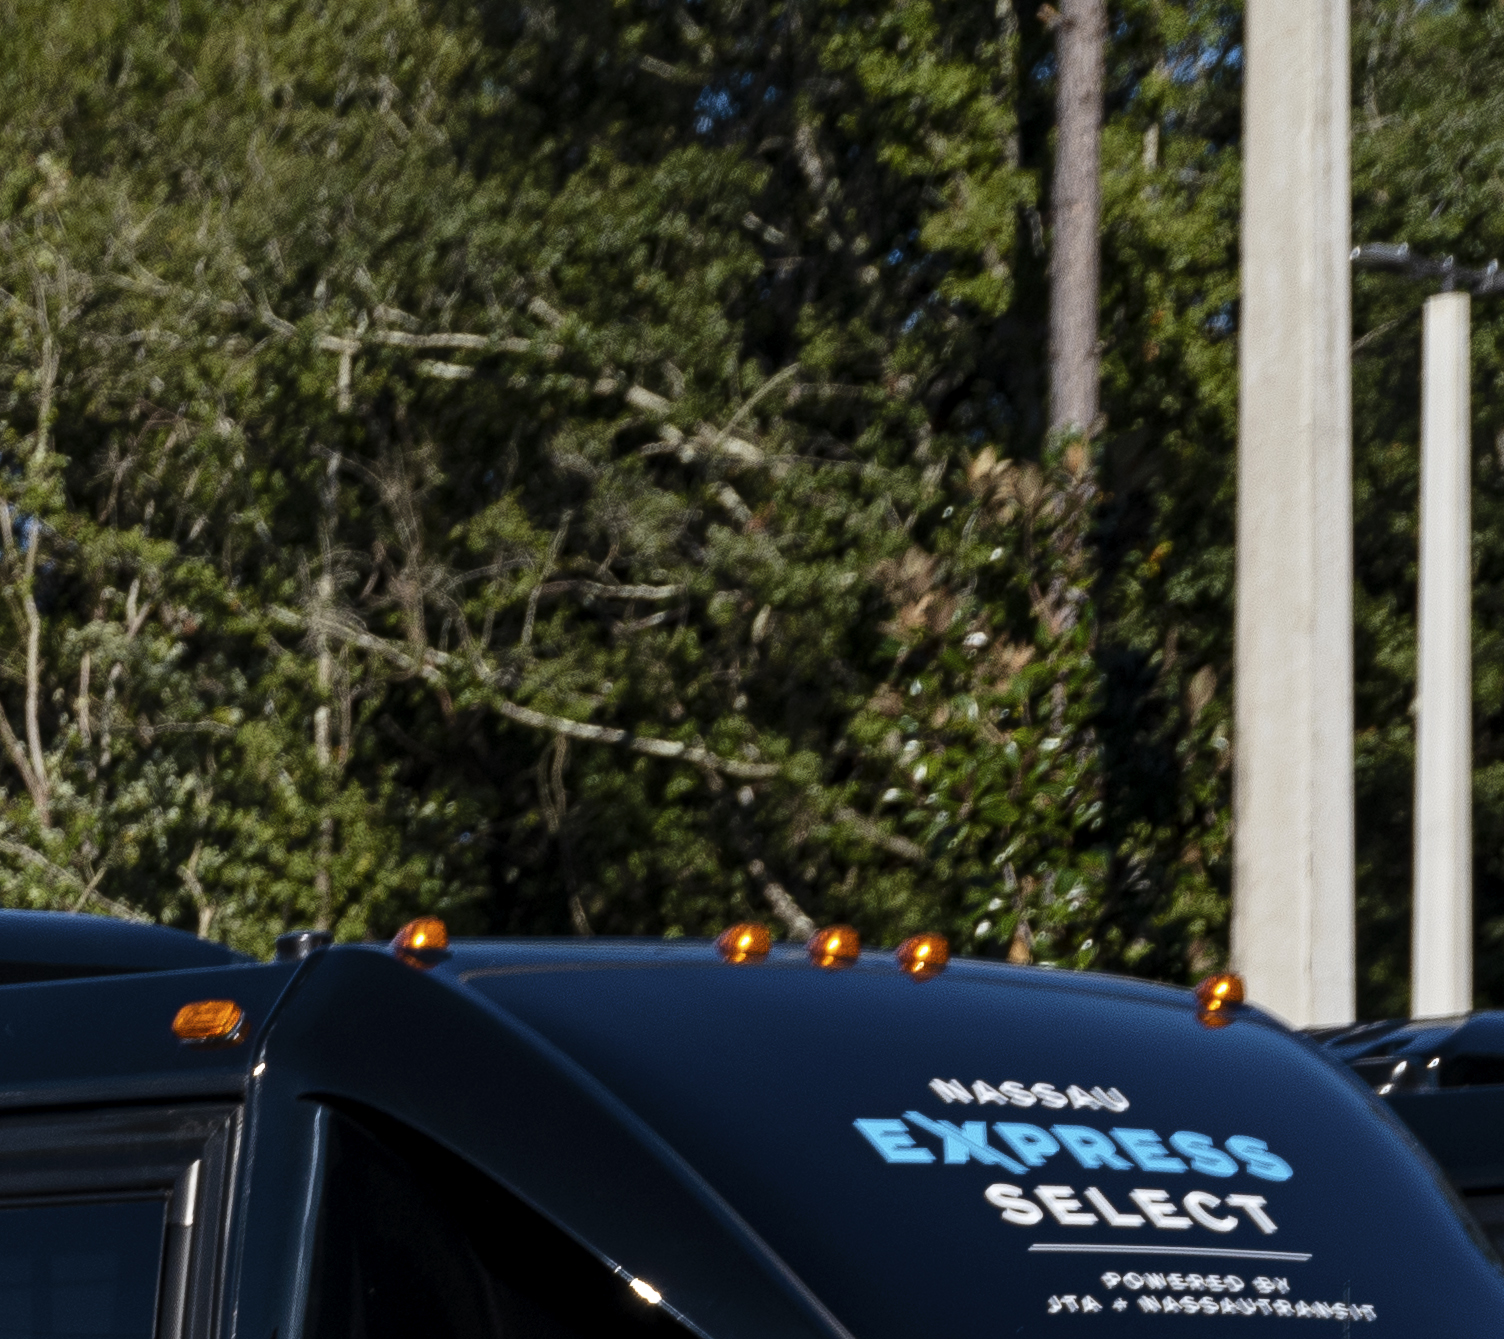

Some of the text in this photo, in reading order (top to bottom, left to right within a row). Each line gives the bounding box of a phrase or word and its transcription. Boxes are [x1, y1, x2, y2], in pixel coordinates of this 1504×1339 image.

[928, 1077, 1130, 1113] NASSAU
[852, 1110, 1294, 1182] EXPRESS
[984, 1183, 1278, 1235] SELECT
[1100, 1271, 1291, 1294] POWERED BY
[1047, 1295, 1104, 1314] JTA
[1136, 1295, 1378, 1322] NASSAUTRANSIT
